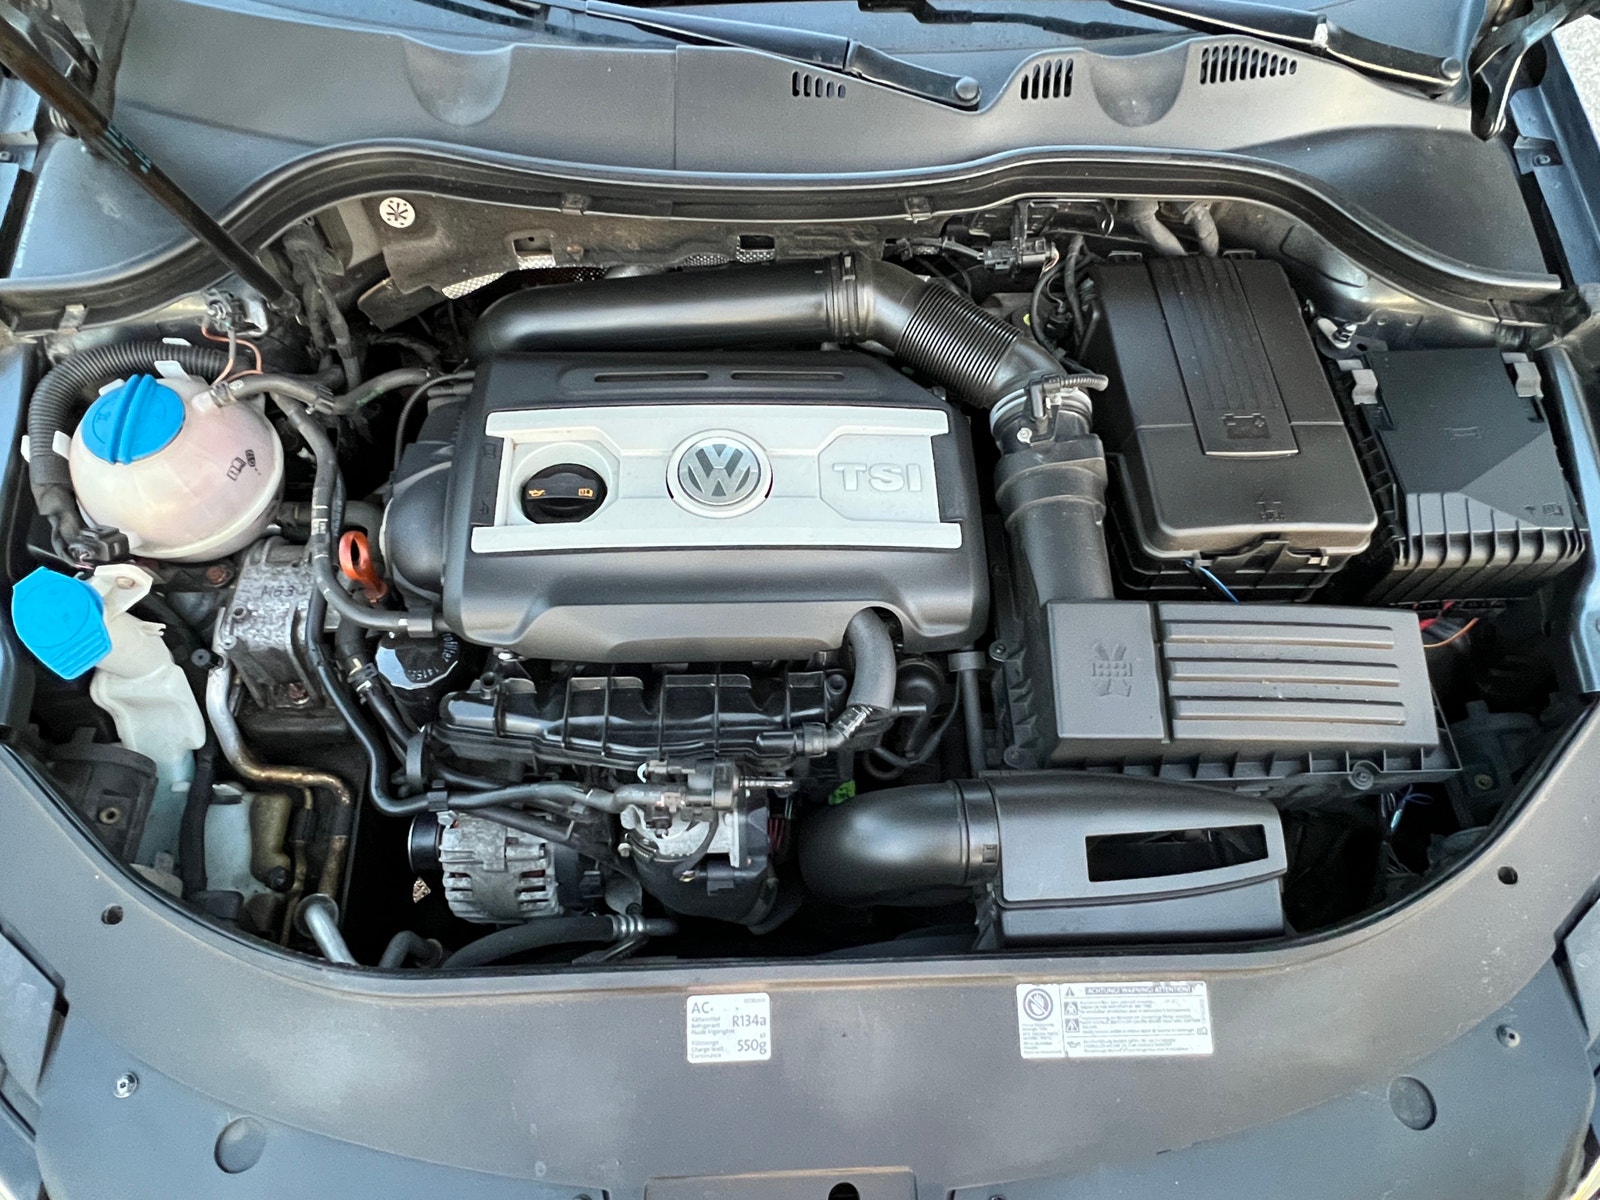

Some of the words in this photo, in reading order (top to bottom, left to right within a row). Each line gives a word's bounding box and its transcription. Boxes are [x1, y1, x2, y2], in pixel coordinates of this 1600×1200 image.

[832, 463, 922, 492] TSI
[732, 1014, 767, 1027] R134a
[737, 1038, 767, 1055] 550g
